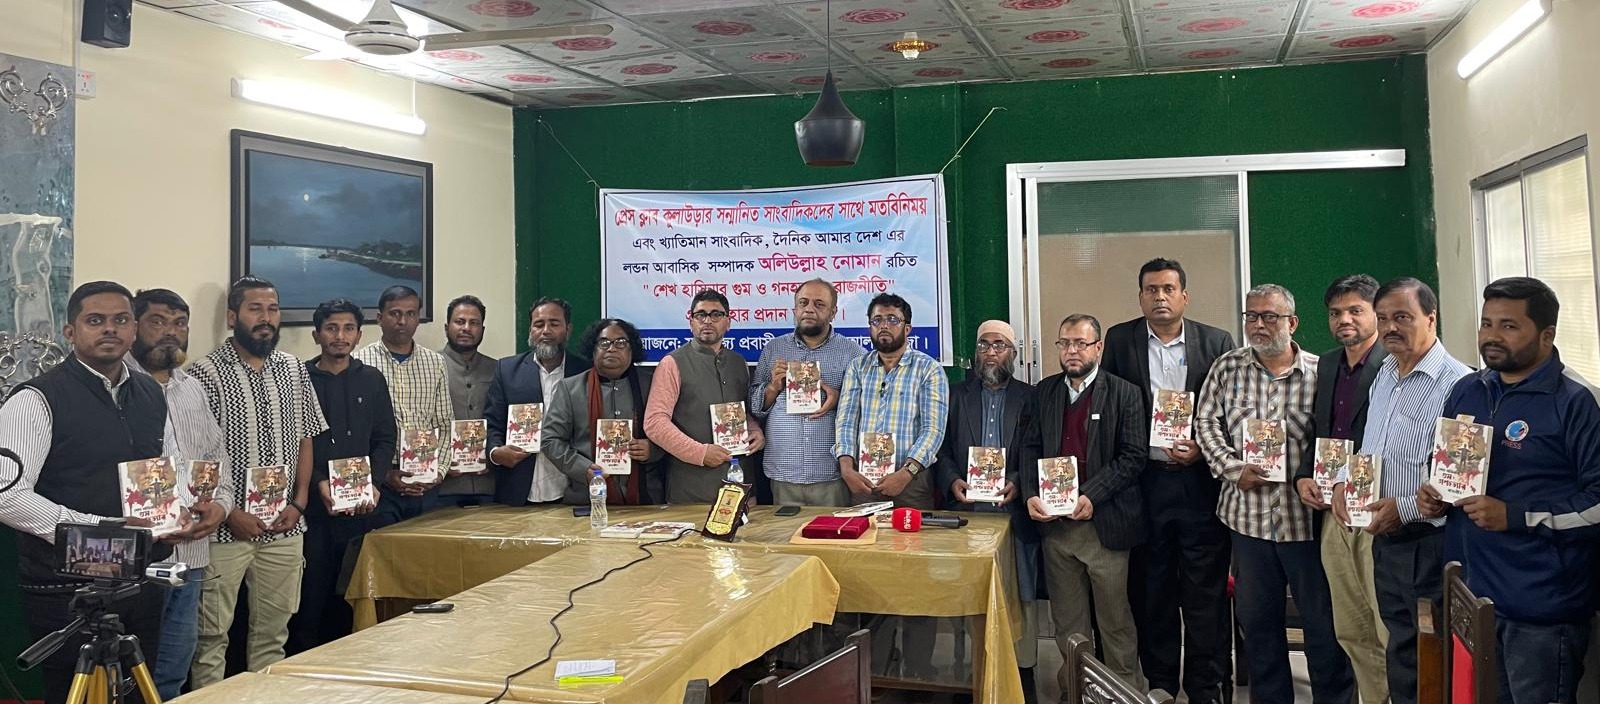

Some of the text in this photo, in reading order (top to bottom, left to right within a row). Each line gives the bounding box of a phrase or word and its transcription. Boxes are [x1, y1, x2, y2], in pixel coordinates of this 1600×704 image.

[615, 207, 635, 226] প্রেস
[639, 208, 659, 228] ক্লাব
[663, 204, 713, 229] কুলাউড়ার
[764, 200, 835, 223] সাংবাদিকদের
[838, 200, 864, 218] সাথে
[869, 192, 927, 217] মতবিনিময়
[633, 237, 656, 250] এবং
[659, 233, 706, 249] খ্যাতিমান
[773, 230, 812, 246] দৈনিক
[815, 231, 852, 243] আমার
[856, 230, 882, 243] দেশ
[886, 230, 905, 241] এর
[623, 252, 918, 274] লন্ডন আবাসিক সম্পাদক অলিউল্লাহ নোমান রচিত
[653, 283, 677, 297] শেখ
[731, 283, 751, 296] গুম
[757, 285, 767, 295] ও
[754, 308, 788, 321] প্রদান
